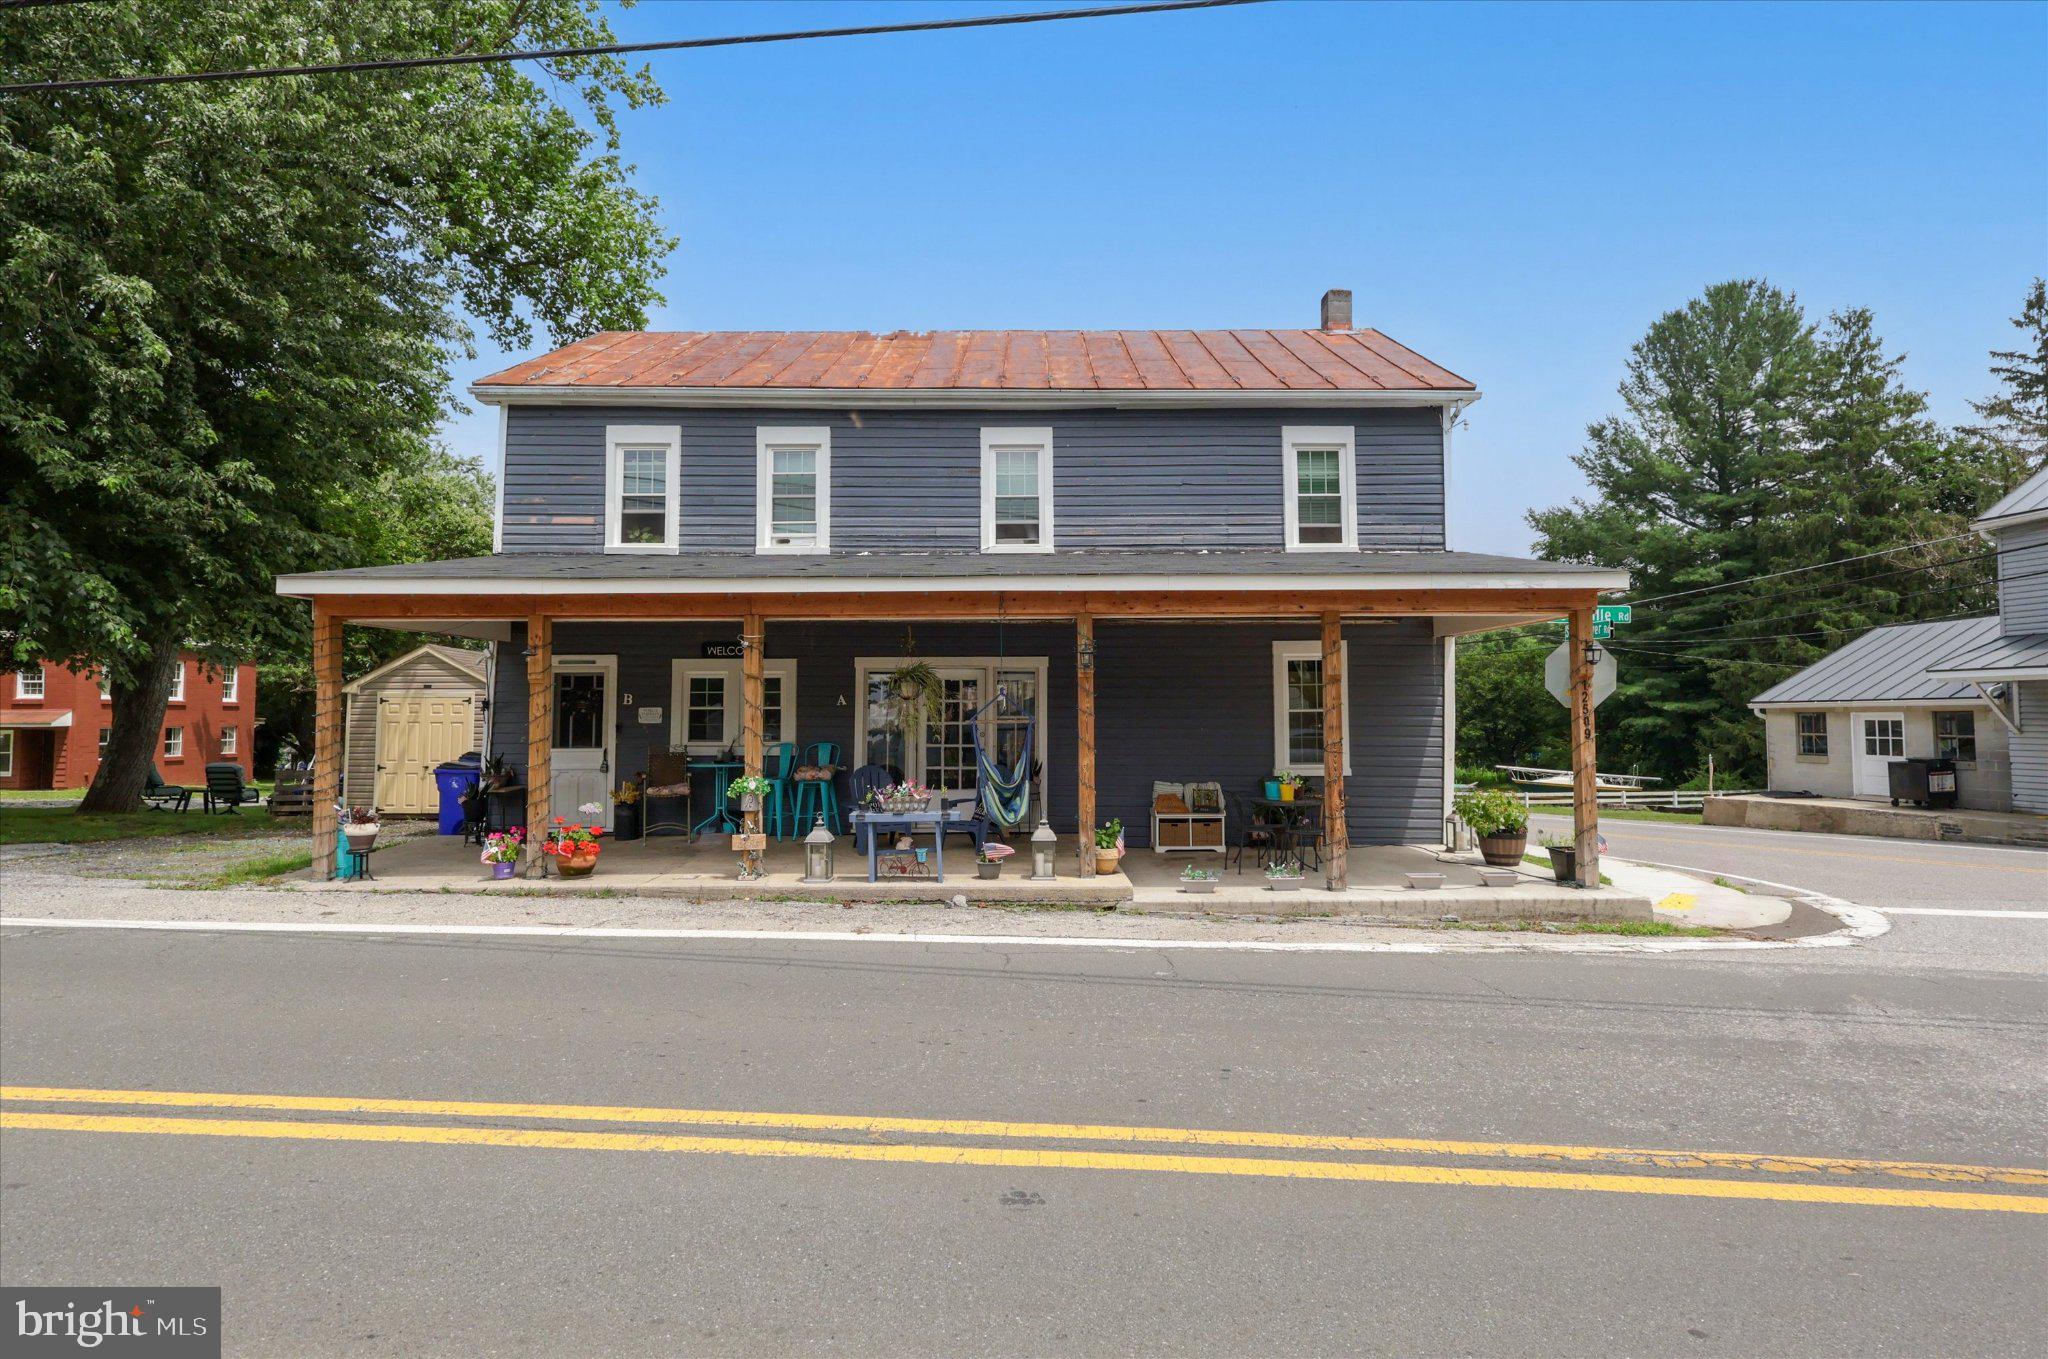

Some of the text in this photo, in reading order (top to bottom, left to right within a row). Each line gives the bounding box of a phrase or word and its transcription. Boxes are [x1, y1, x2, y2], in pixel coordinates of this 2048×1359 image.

[1618, 612, 1629, 621] Rd
[623, 694, 633, 705] B
[837, 694, 847, 706] A
